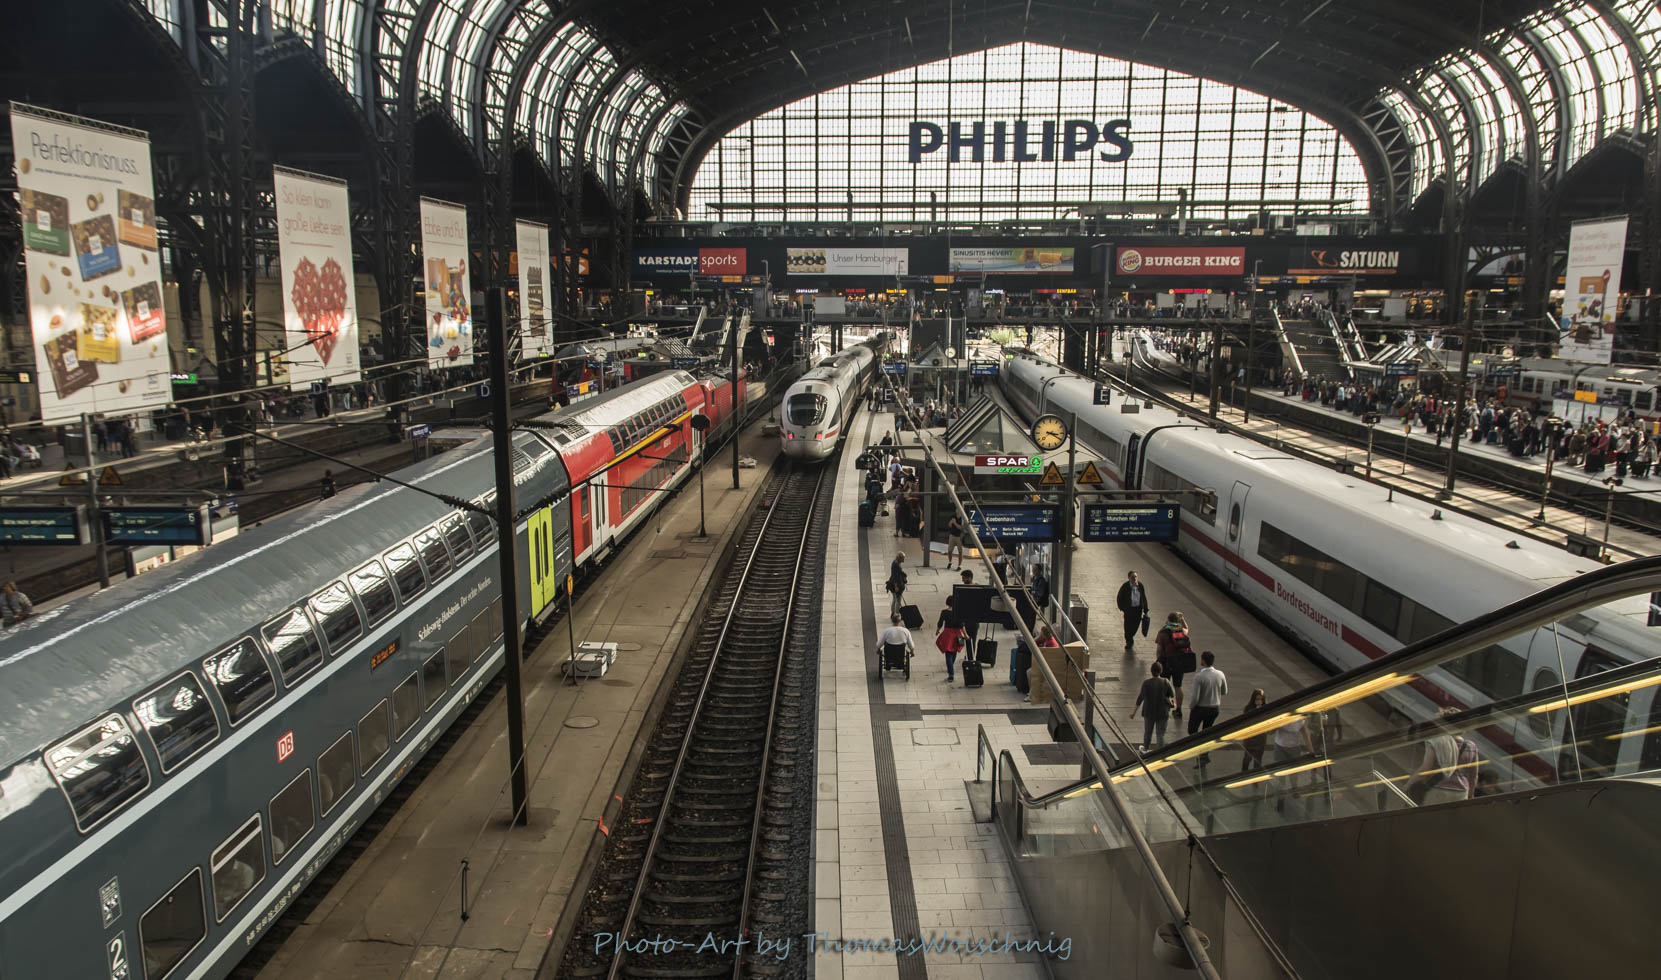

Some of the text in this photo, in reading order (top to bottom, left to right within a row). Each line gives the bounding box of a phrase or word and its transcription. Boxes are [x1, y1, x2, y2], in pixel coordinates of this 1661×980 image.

[908, 119, 1134, 163] PHILIPS
[638, 254, 738, 268] KARSTADT sports
[832, 253, 854, 263] Unser
[1121, 259, 1140, 268] KING
[1145, 256, 1241, 267] BURGER KING
[1340, 250, 1399, 268] SATURN
[481, 385, 490, 397] D
[884, 388, 892, 401] E
[1101, 389, 1109, 402] E
[987, 457, 1028, 466] SPAR
[997, 466, 1041, 475] express
[970, 510, 976, 520] 7
[1168, 509, 1174, 519] 8
[1277, 582, 1339, 637] Bordrestaurant
[279, 735, 293, 757] DB
[110, 938, 124, 971] 2
